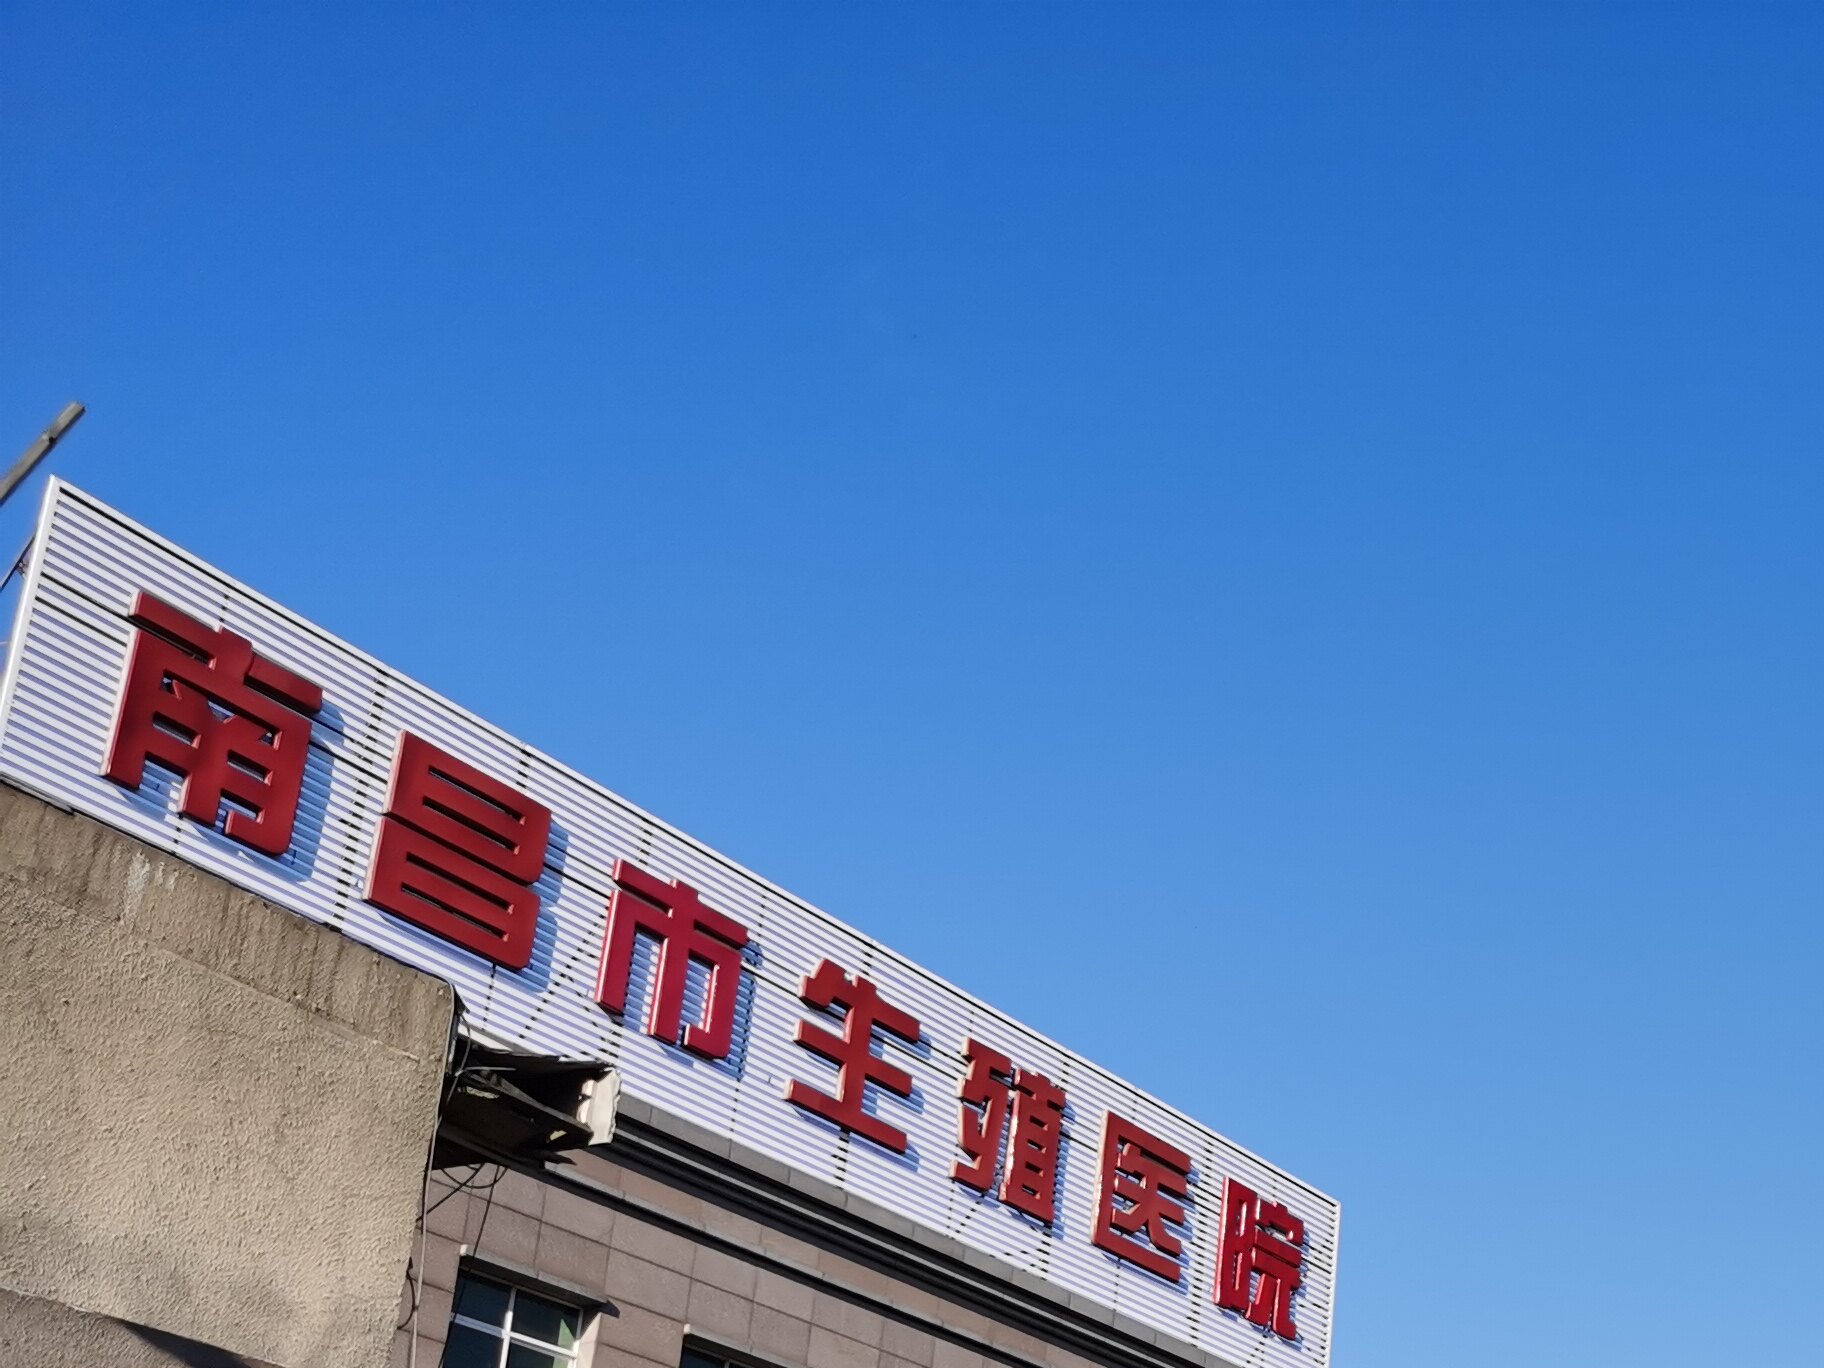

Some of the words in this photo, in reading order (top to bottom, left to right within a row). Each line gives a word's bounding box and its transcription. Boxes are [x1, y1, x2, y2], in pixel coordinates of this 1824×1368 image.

[104, 589, 1306, 1342] 南昌市生殖医院
